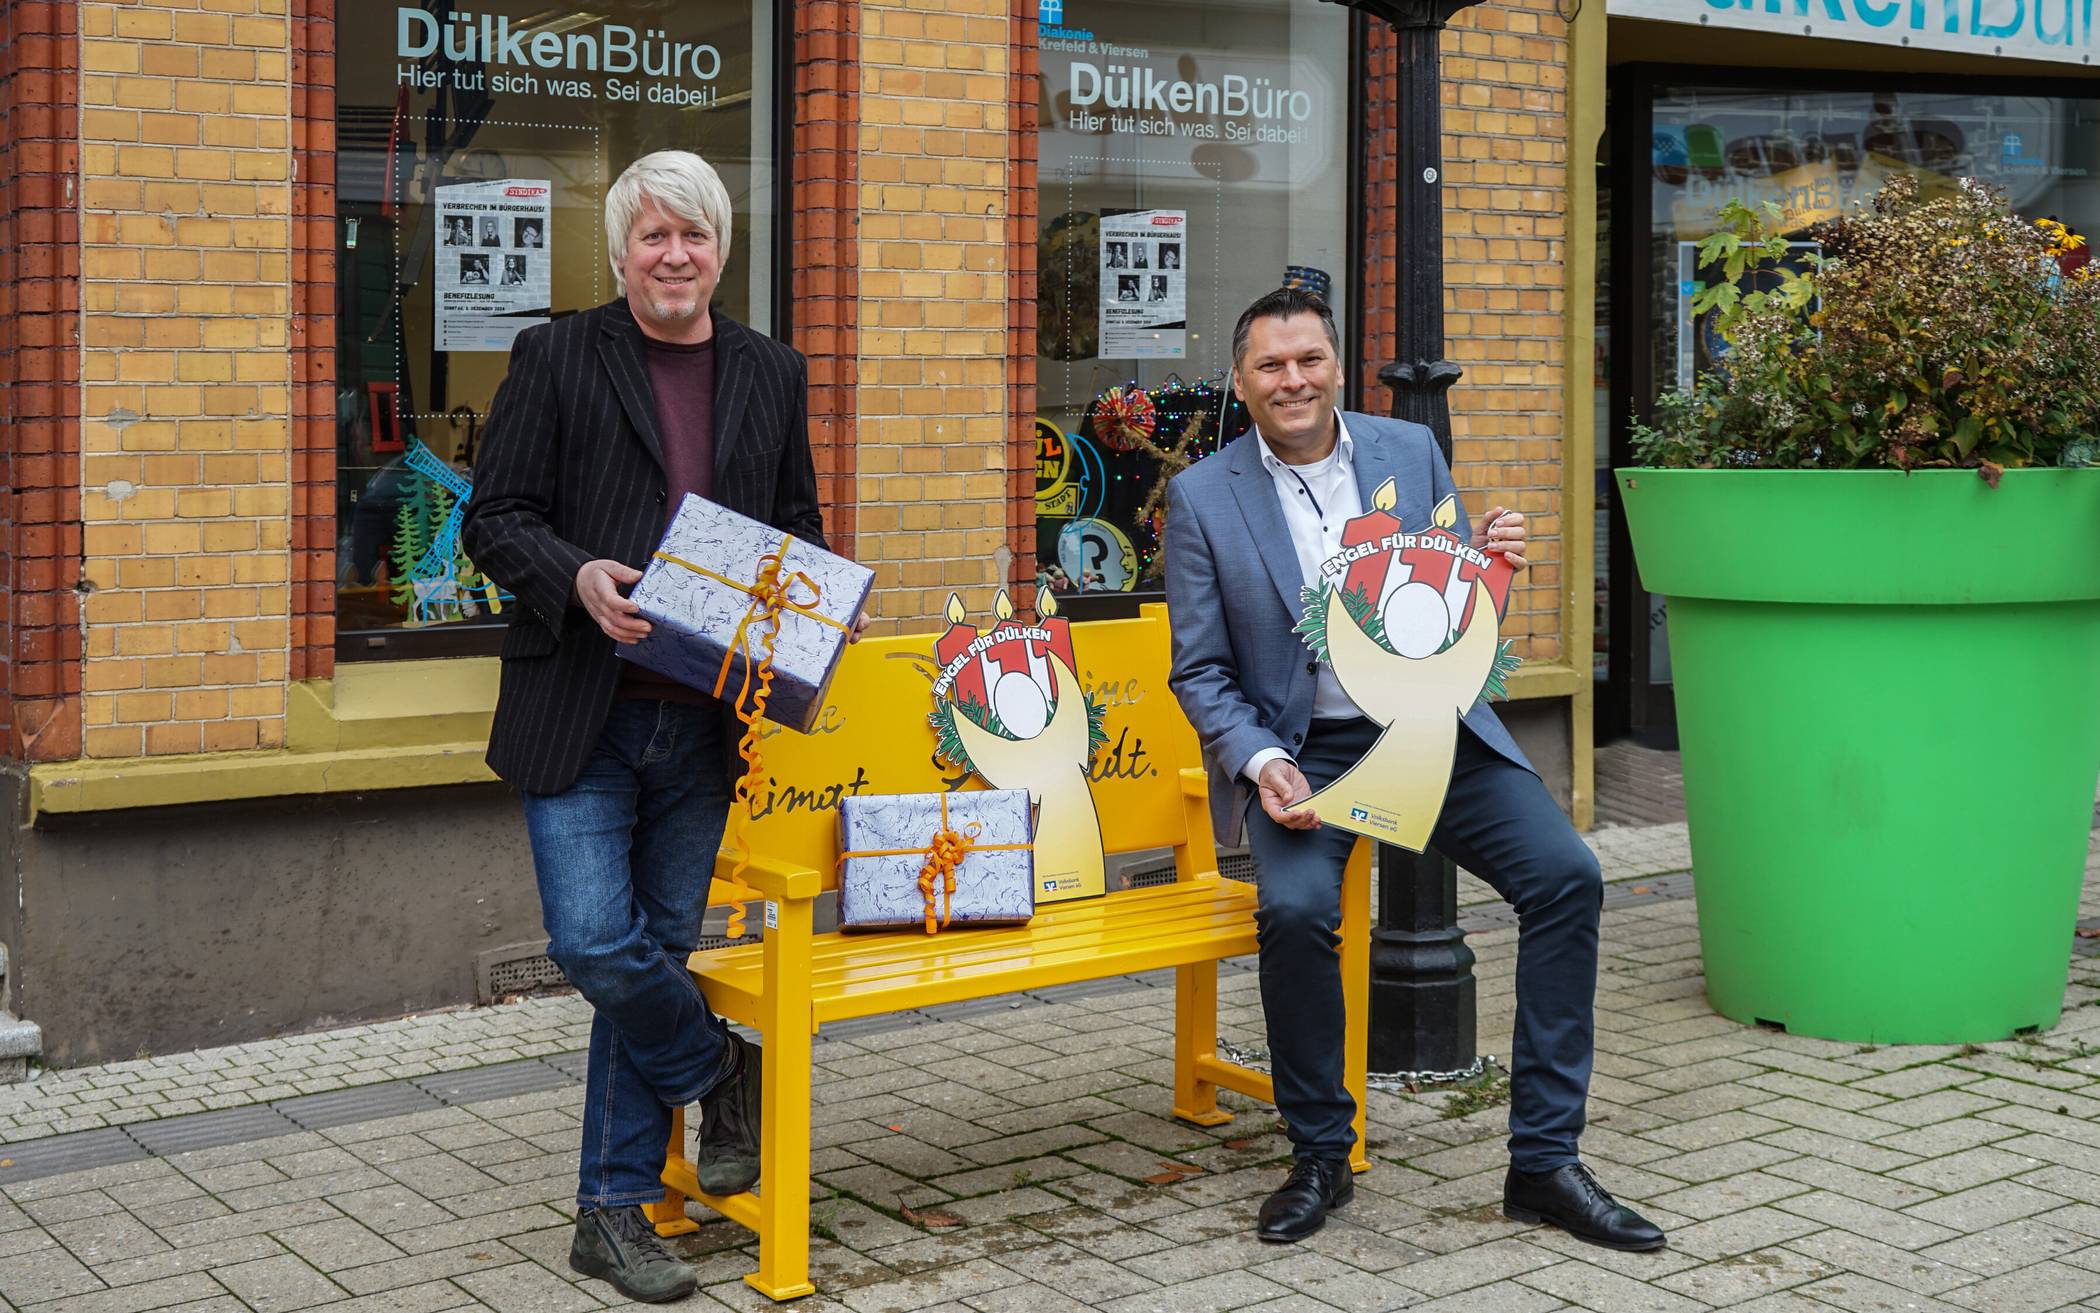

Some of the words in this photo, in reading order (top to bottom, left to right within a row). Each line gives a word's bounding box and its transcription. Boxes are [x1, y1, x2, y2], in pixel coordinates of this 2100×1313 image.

[397, 7, 721, 80] DülkenBüro
[1037, 25, 1094, 41] Diakonie
[1038, 38, 1086, 53] Krefeld
[1088, 42, 1099, 54] &
[1100, 42, 1149, 59] Viersen
[397, 63, 446, 88] Hier
[452, 68, 485, 91] tut
[491, 71, 538, 94] sich
[546, 79, 597, 98] was.
[605, 78, 640, 101] Sei
[1070, 61, 1311, 121] DülkenBüro
[1070, 110, 1106, 131] Hier
[1110, 114, 1135, 133] tut
[1140, 116, 1175, 136] sich
[1181, 122, 1219, 139] was.
[1224, 120, 1251, 141] Sei
[443, 202, 487, 210] VERBRECHEN
[489, 203, 497, 211] IM
[443, 292, 495, 300] BENEFIZLESUNG
[1045, 489, 1072, 511] STADT
[1321, 541, 1379, 577] ENGEL
[1381, 532, 1418, 550] FÜR
[1420, 535, 1492, 570] DÜLKEN
[934, 653, 970, 697] ENGEL
[967, 636, 994, 657] FÜR
[995, 626, 1052, 642] DÜLKEN
